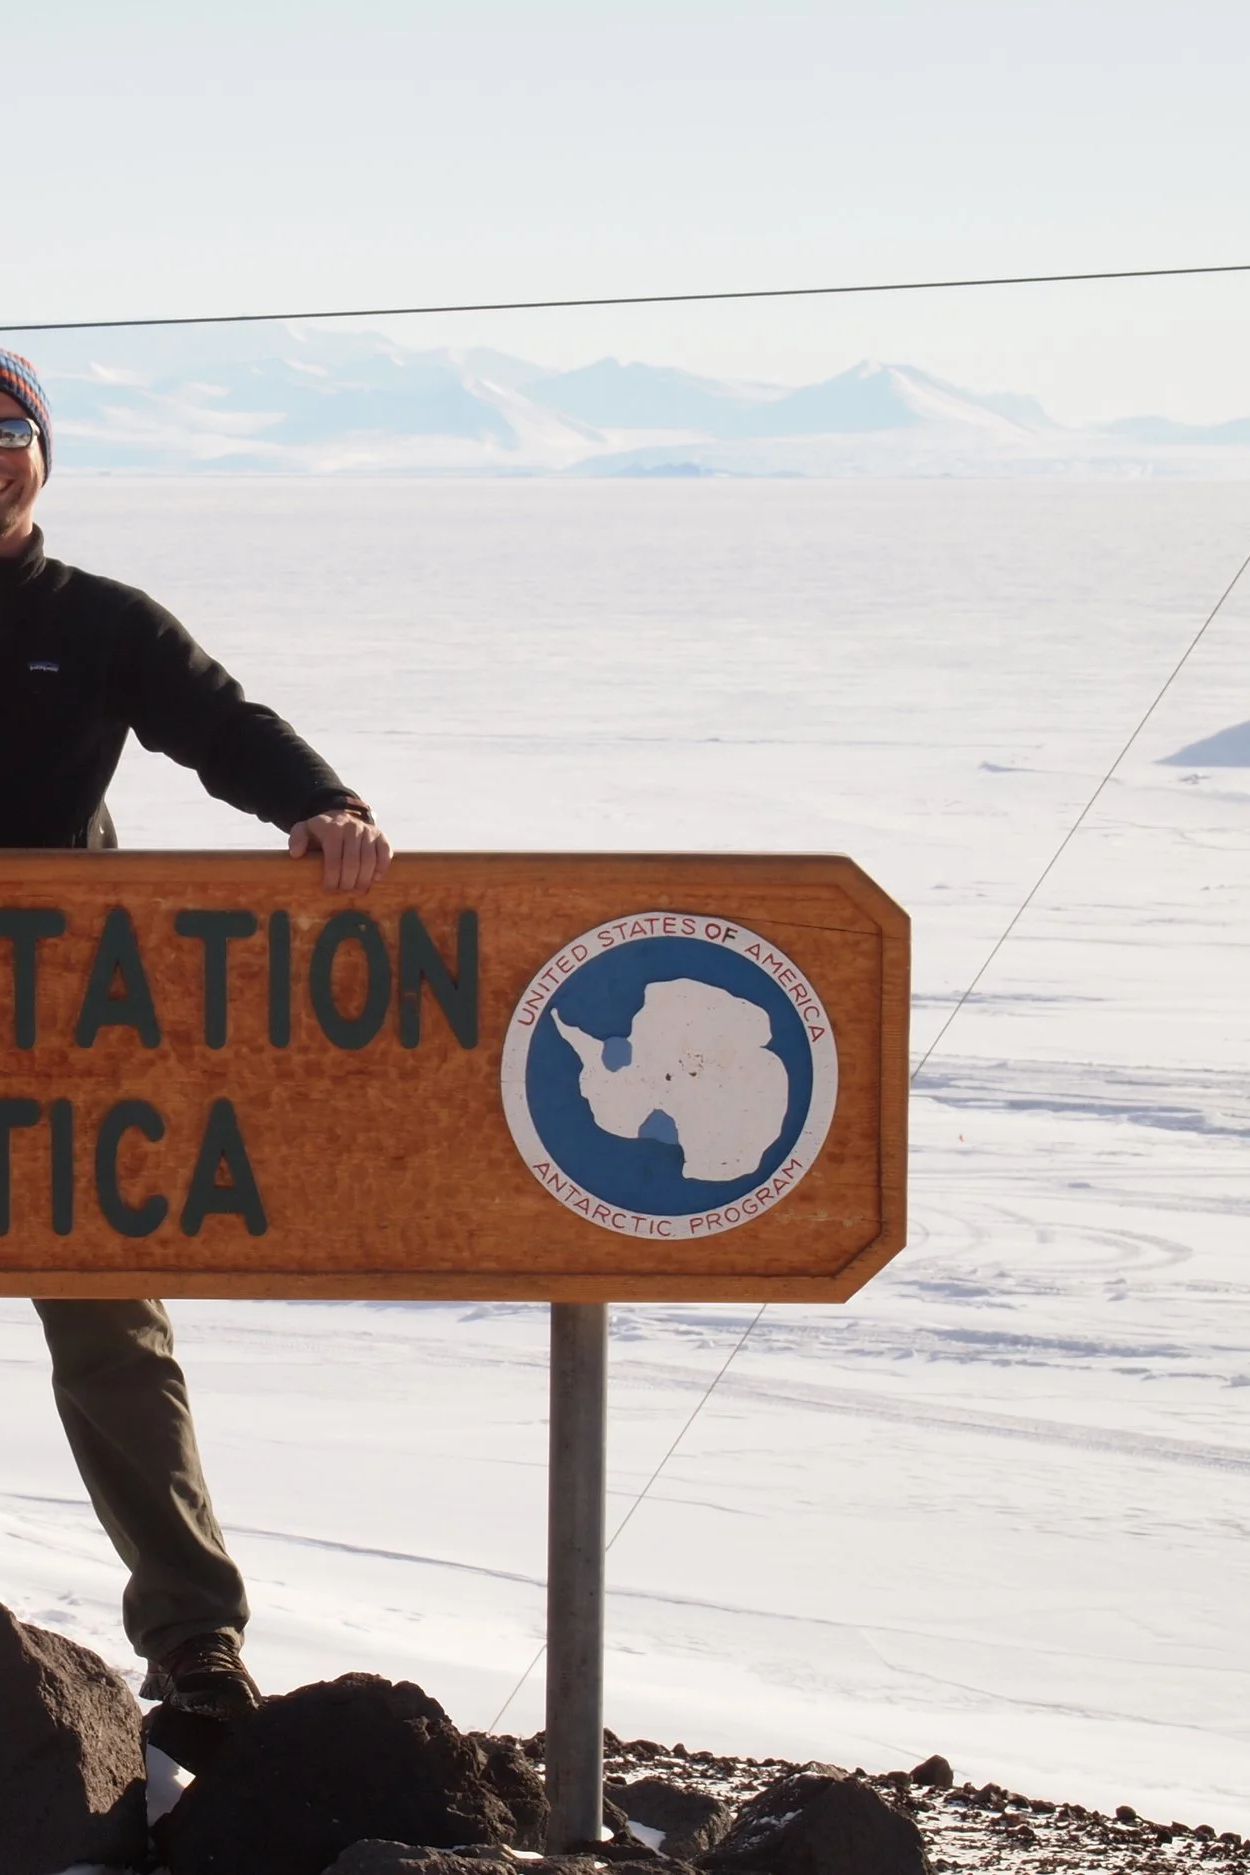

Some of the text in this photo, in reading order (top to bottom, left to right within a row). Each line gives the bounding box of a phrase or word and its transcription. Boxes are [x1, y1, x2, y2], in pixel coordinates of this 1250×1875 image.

[517, 917, 826, 1043] UNITED STATES OF AMERICA
[533, 1158, 803, 1237] ANTARCTIC PROGRAM
